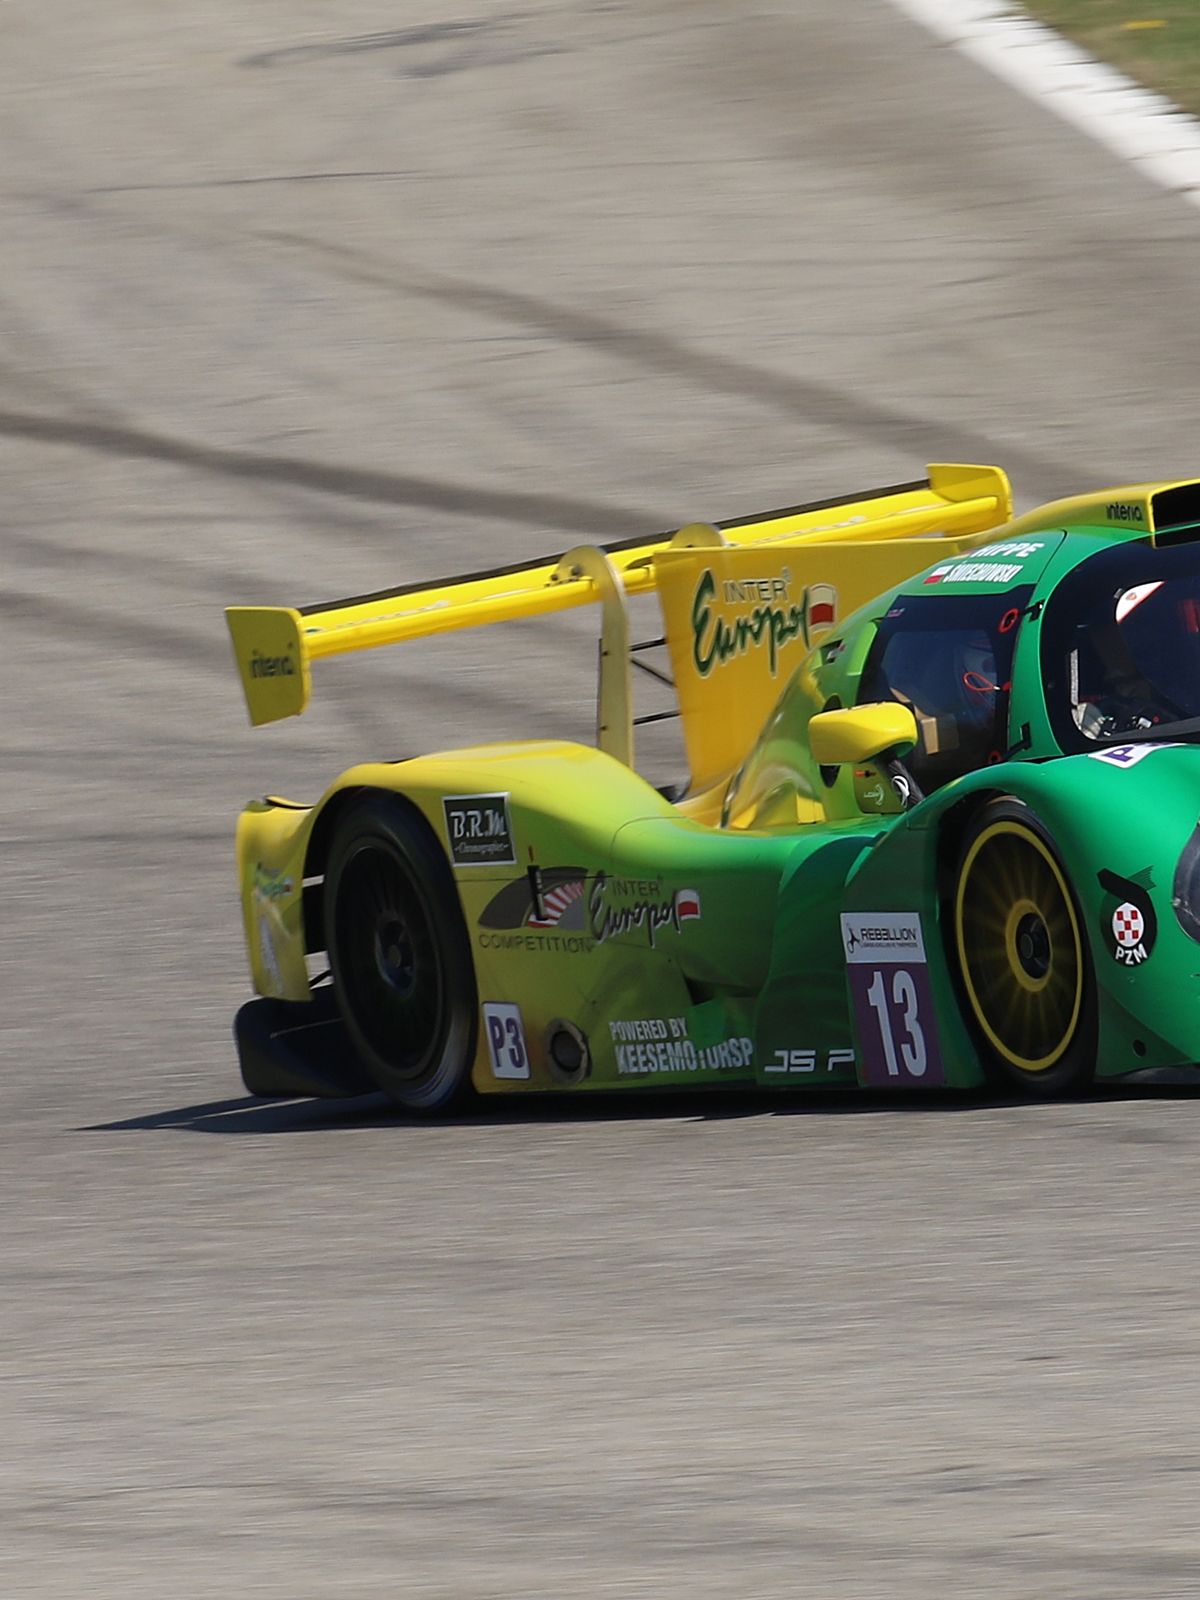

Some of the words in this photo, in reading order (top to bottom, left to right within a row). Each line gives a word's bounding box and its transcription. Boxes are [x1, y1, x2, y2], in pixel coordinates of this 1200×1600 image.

[723, 576, 789, 603] INTER
[692, 568, 811, 679] Europol
[612, 879, 661, 897] INTER
[590, 869, 680, 950] Europol
[479, 934, 596, 954] COMPETITION
[1115, 943, 1148, 966] PZM
[609, 1018, 668, 1042] POWERED
[670, 1017, 689, 1038] BY
[867, 970, 928, 1077] 13
[487, 1015, 526, 1069] P3
